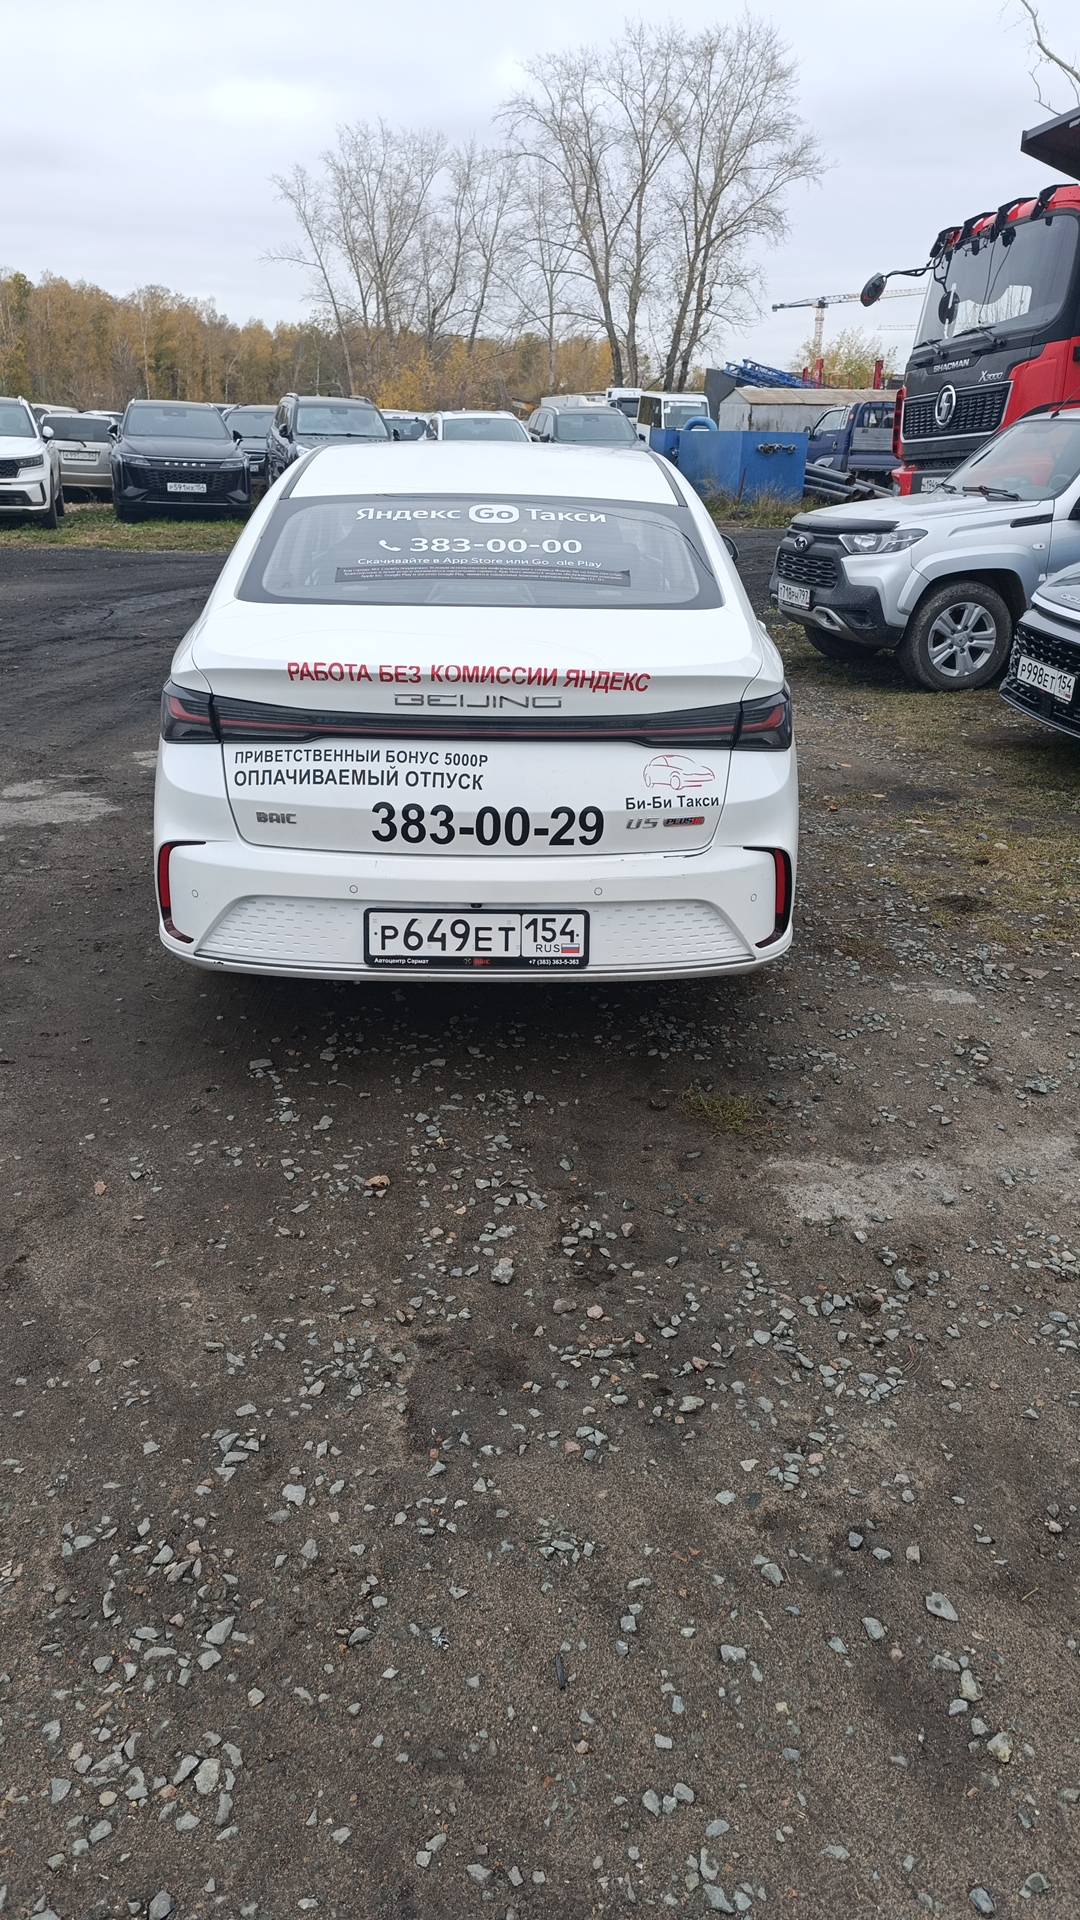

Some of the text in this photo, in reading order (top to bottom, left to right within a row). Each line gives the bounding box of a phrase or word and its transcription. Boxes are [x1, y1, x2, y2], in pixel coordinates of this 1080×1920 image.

[933, 359, 970, 373] SHACMAN
[356, 506, 607, 522] Яндекс Go Такси
[410, 538, 582, 553] 383-00-00
[358, 557, 430, 565] Скачивайте
[443, 557, 468, 565] App
[471, 557, 503, 565] Store
[577, 560, 601, 568] Play
[287, 662, 652, 693] РАБОТА БЕЗ КОМИССИИ ЯНДЕКС
[1020, 662, 1072, 692] Р998ЕТ 154
[394, 693, 563, 709] BEIJING
[386, 750, 439, 765] БОНУС
[445, 752, 488, 767] 5000Р
[234, 766, 484, 791] ОПЛАЧИВАЕМЫЙ ОТПУСК
[625, 795, 719, 810] Би-Би Такси
[256, 811, 297, 825] BAIC
[372, 801, 604, 846] 383-00-29
[381, 917, 575, 952] Р649ЕТ 154
[535, 944, 560, 953] RUS
[374, 957, 429, 965] Автоцентр Сармат
